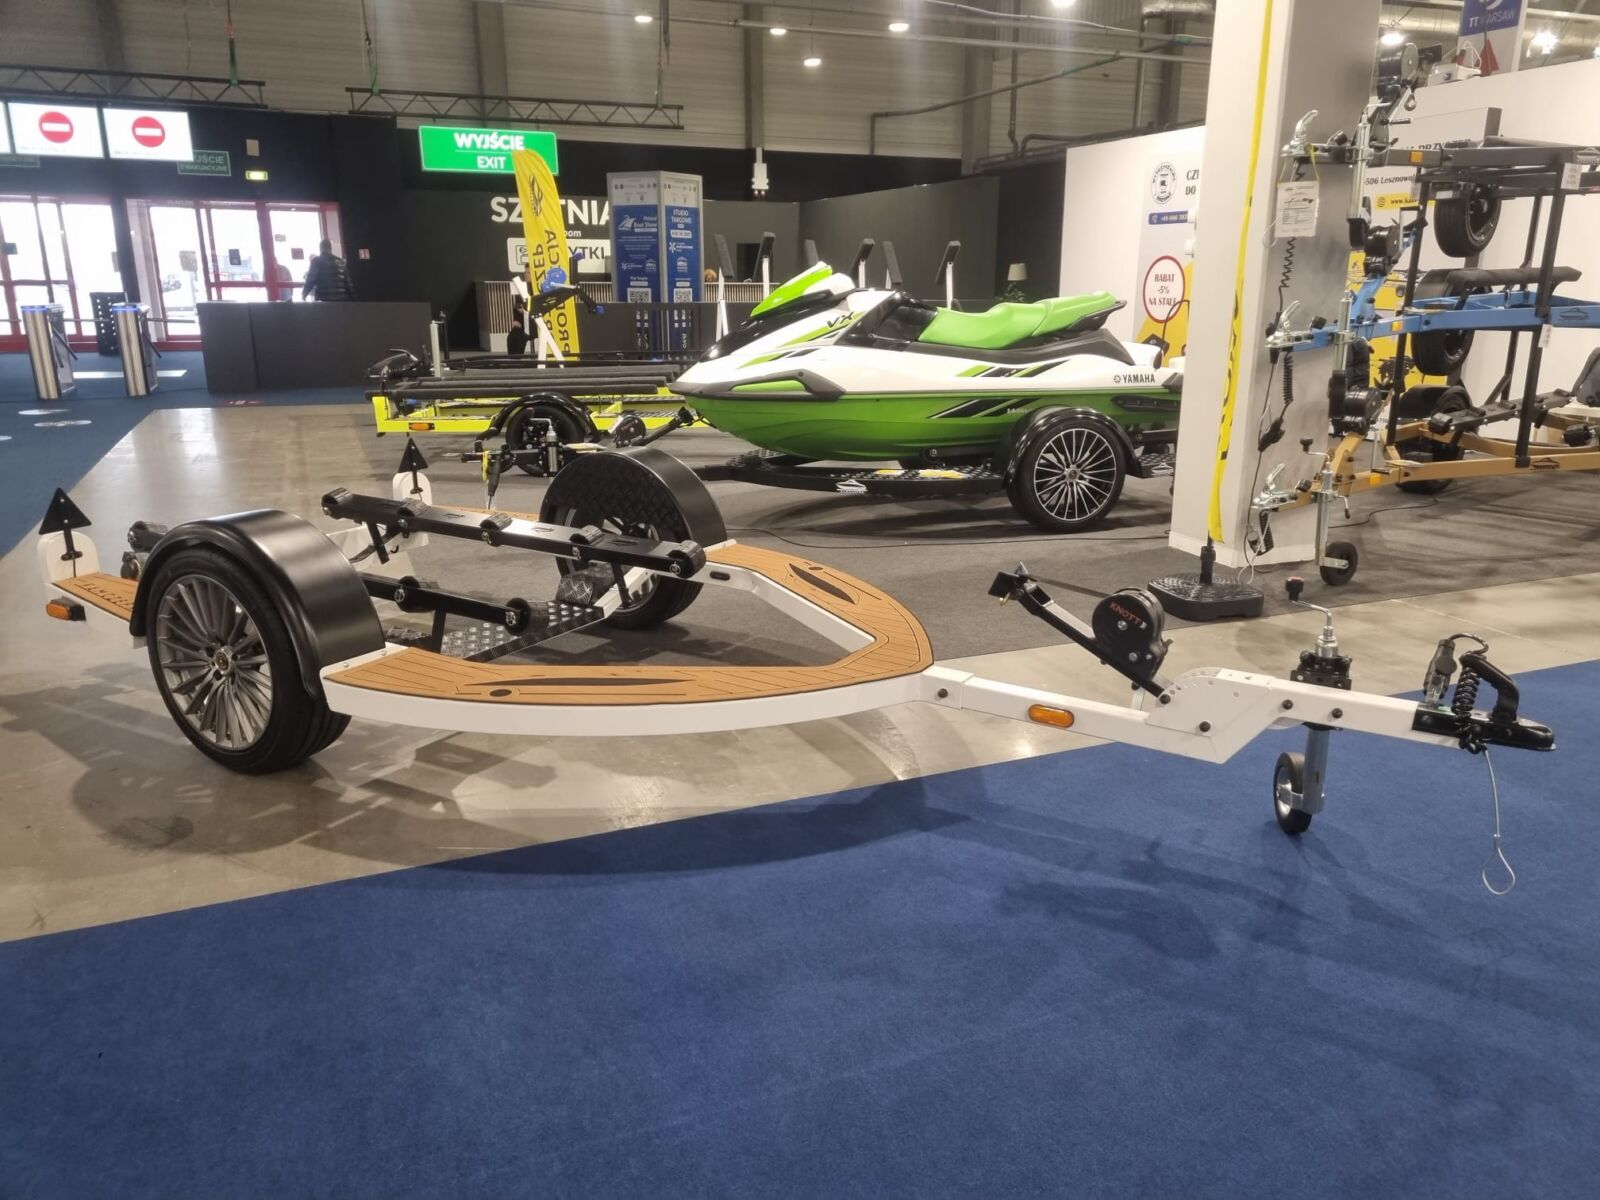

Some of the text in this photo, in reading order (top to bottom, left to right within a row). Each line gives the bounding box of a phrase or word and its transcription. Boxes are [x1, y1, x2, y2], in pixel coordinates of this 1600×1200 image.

[454, 131, 525, 151] WYJŚCIE
[477, 156, 506, 169] EXIT
[1154, 273, 1175, 282] RABAT
[1157, 285, 1170, 294] -5%
[1149, 297, 1157, 306] NA
[827, 311, 855, 328] VX
[1122, 374, 1156, 383] YAMAHA
[1110, 602, 1142, 625] KNOTT
